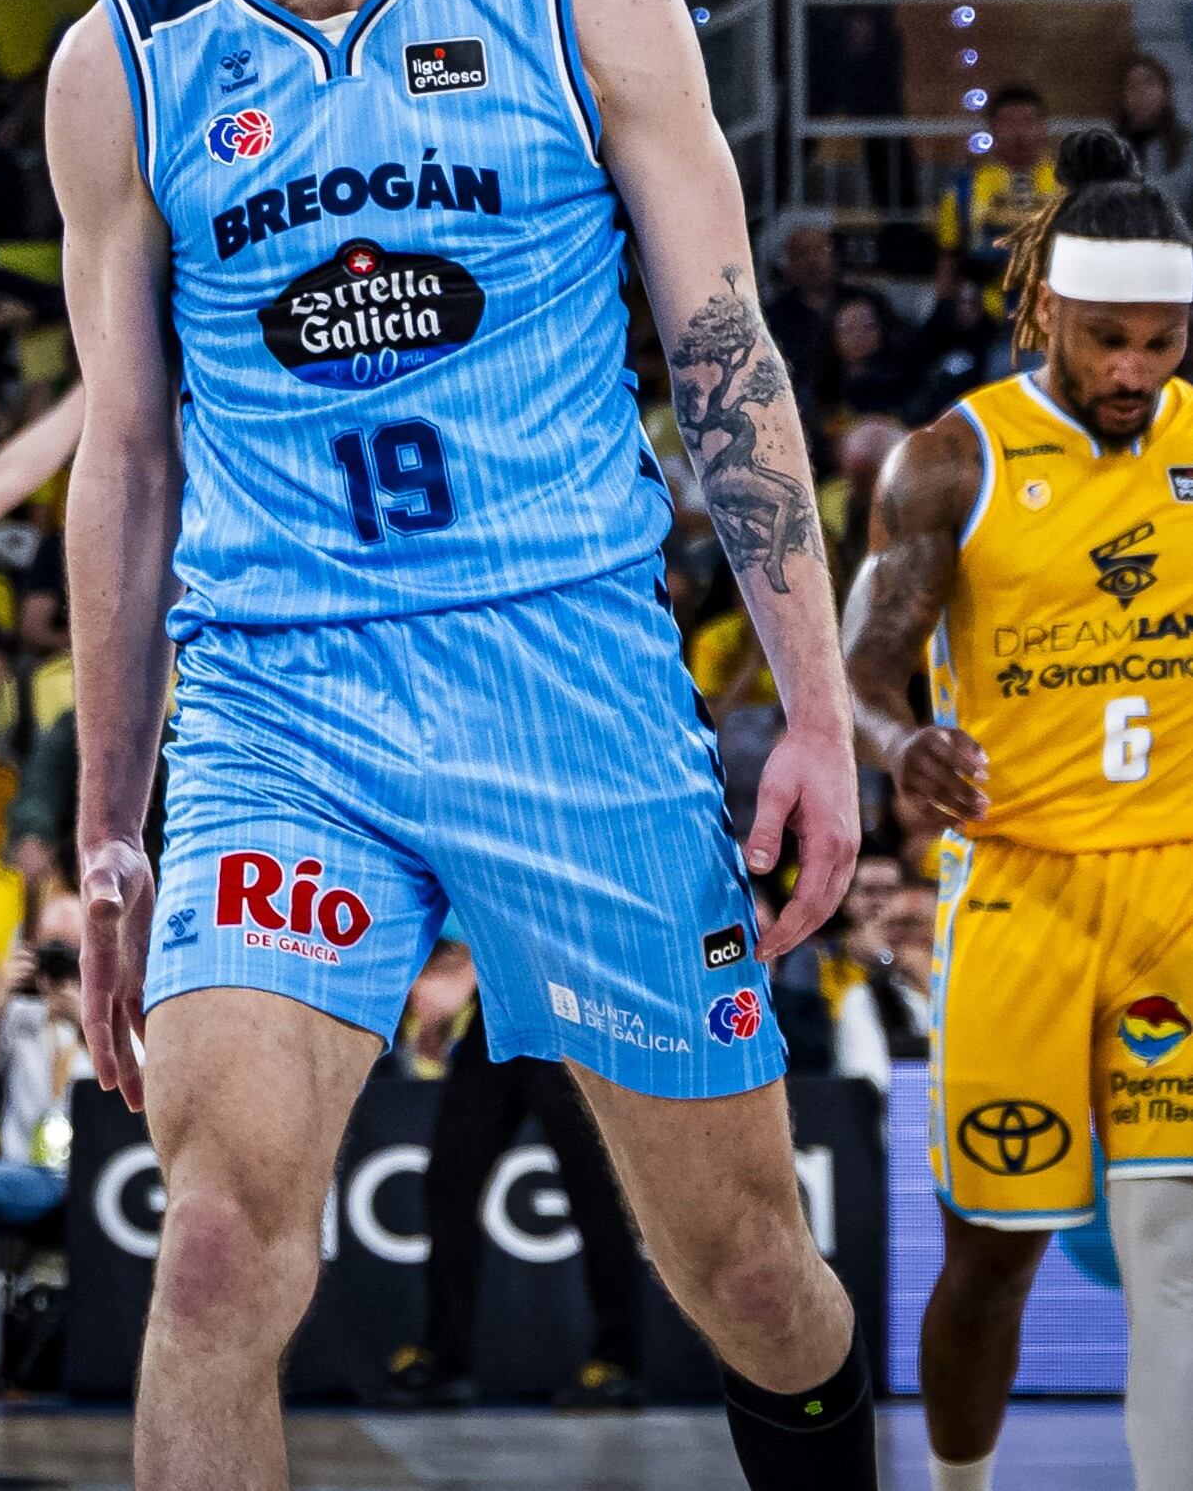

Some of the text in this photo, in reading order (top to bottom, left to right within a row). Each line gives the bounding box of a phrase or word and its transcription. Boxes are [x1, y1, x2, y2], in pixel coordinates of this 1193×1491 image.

[412, 58, 444, 75] liga
[414, 69, 482, 88] endesa
[213, 149, 502, 261] BREOGÁN
[301, 302, 442, 354] Galicia
[330, 416, 459, 546] 19
[1102, 695, 1153, 782] 6
[246, 933, 339, 963] DE GALICIA
[710, 942, 741, 965] acb
[583, 997, 645, 1030] XUNTA
[586, 1012, 691, 1053] DE GALICIA
